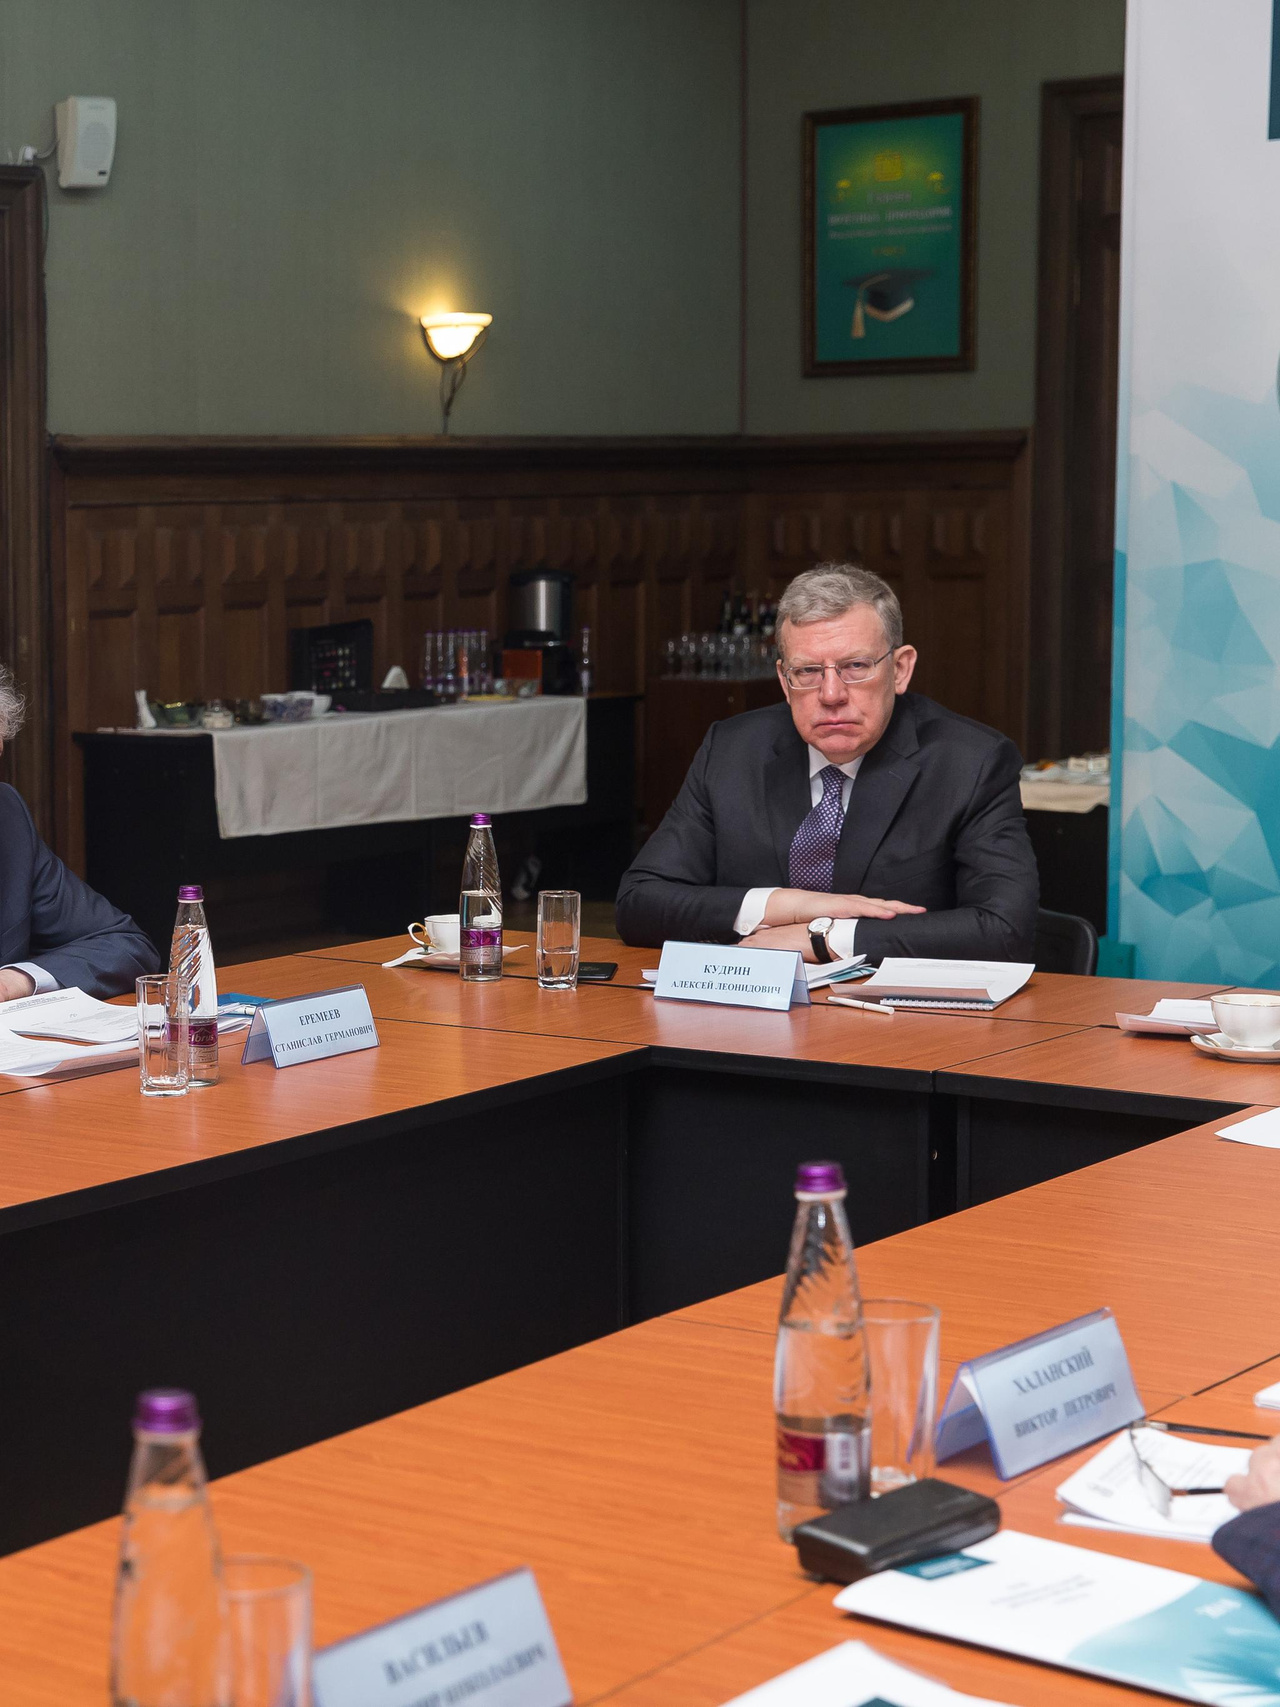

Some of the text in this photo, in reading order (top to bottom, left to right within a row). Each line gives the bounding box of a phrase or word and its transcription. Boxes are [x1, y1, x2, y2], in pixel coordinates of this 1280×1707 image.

[703, 964, 751, 976] КУДРИН
[671, 980, 781, 994] АЛЕКСЕЙ ЛЕОНИДОВИЧ
[299, 1008, 341, 1026] ЕРЕМЕЕВ
[275, 1024, 374, 1053] СТАНИСЛАВ ГЕРМАНОВИЧ
[1014, 1382, 1117, 1438] ВИКТОР ПЕТРОВИЧ
